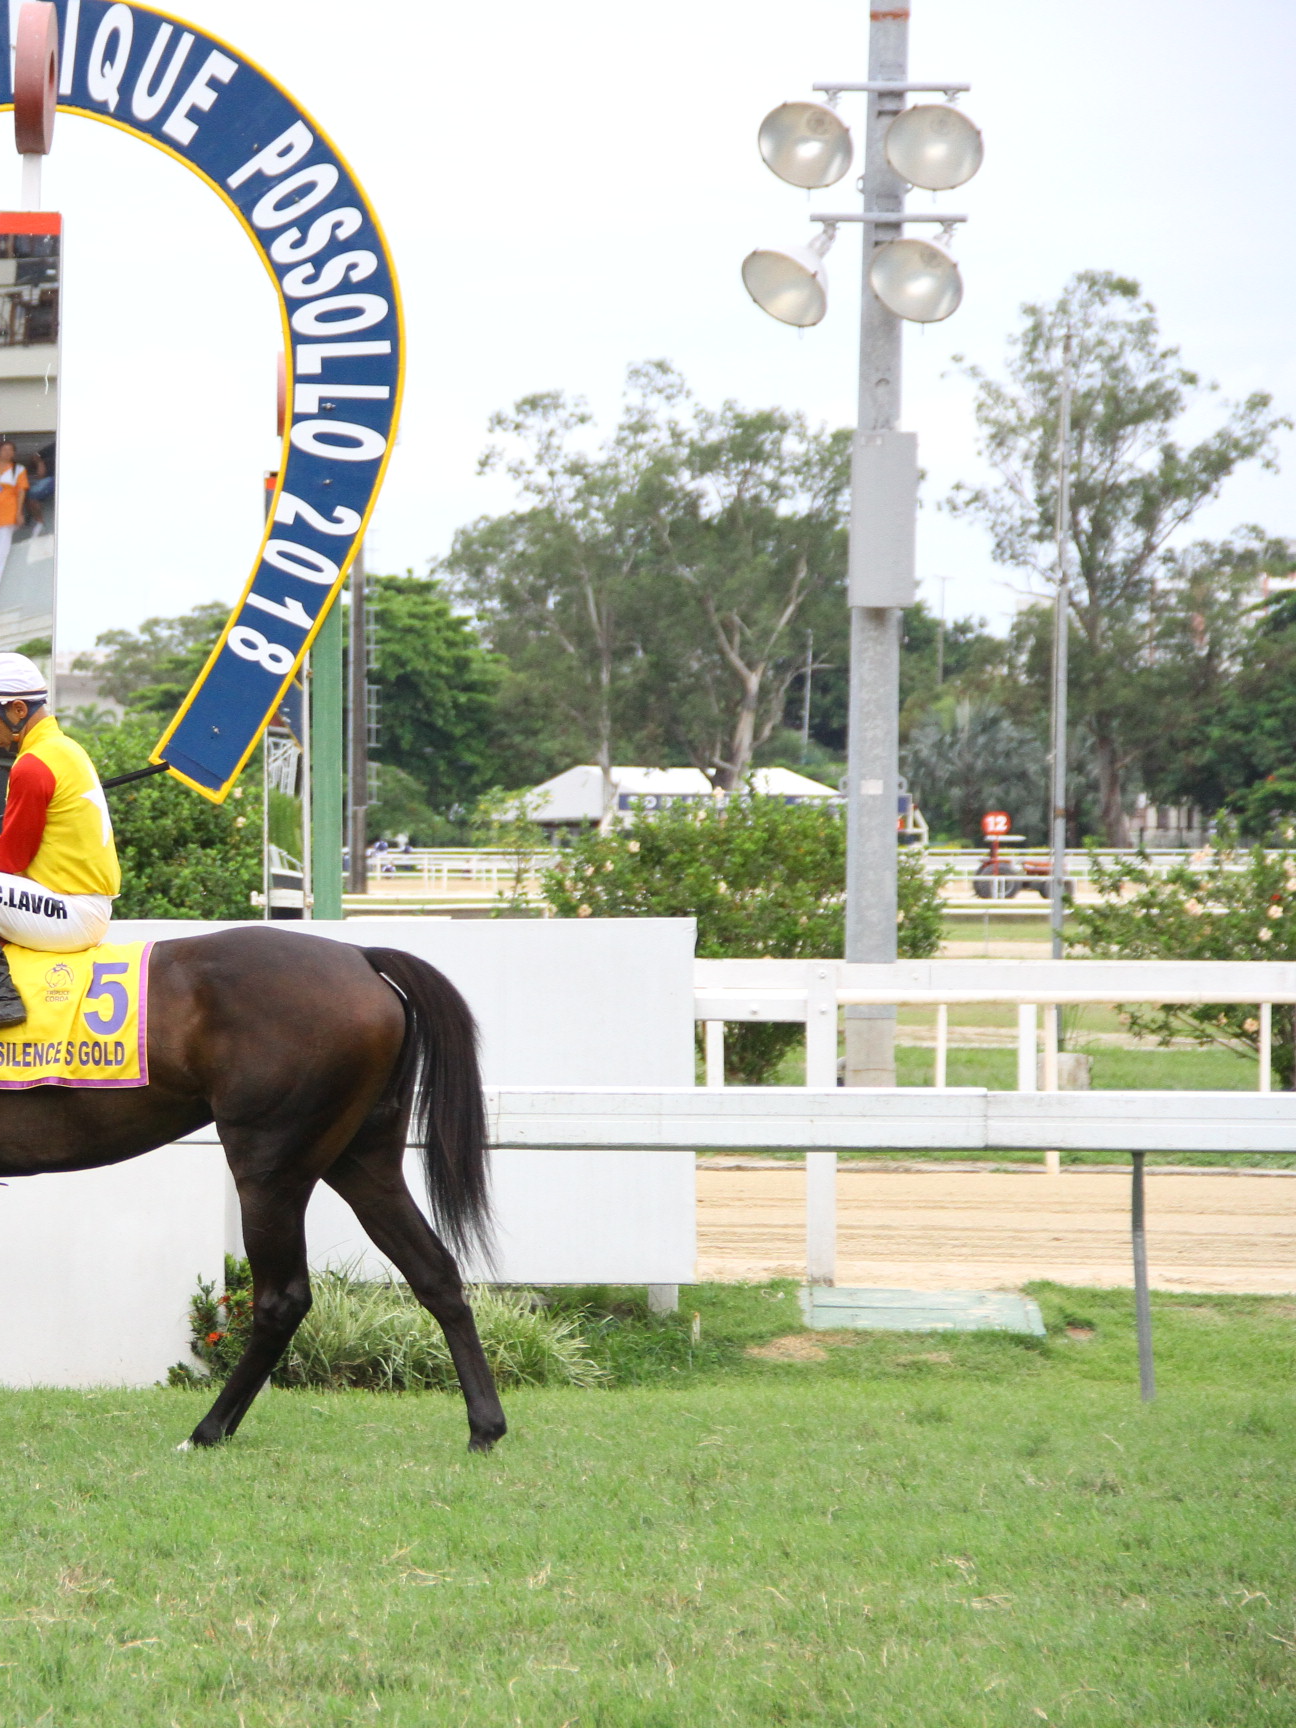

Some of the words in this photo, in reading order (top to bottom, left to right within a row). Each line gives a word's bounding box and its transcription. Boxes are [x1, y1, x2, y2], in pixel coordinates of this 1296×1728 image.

[226, 119, 389, 462] POSSOLLO
[227, 490, 362, 675] 2018
[985, 814, 1008, 832] 12
[83, 961, 130, 1036] 5
[64, 1040, 75, 1066] S
[78, 1041, 125, 1067] GOLD
